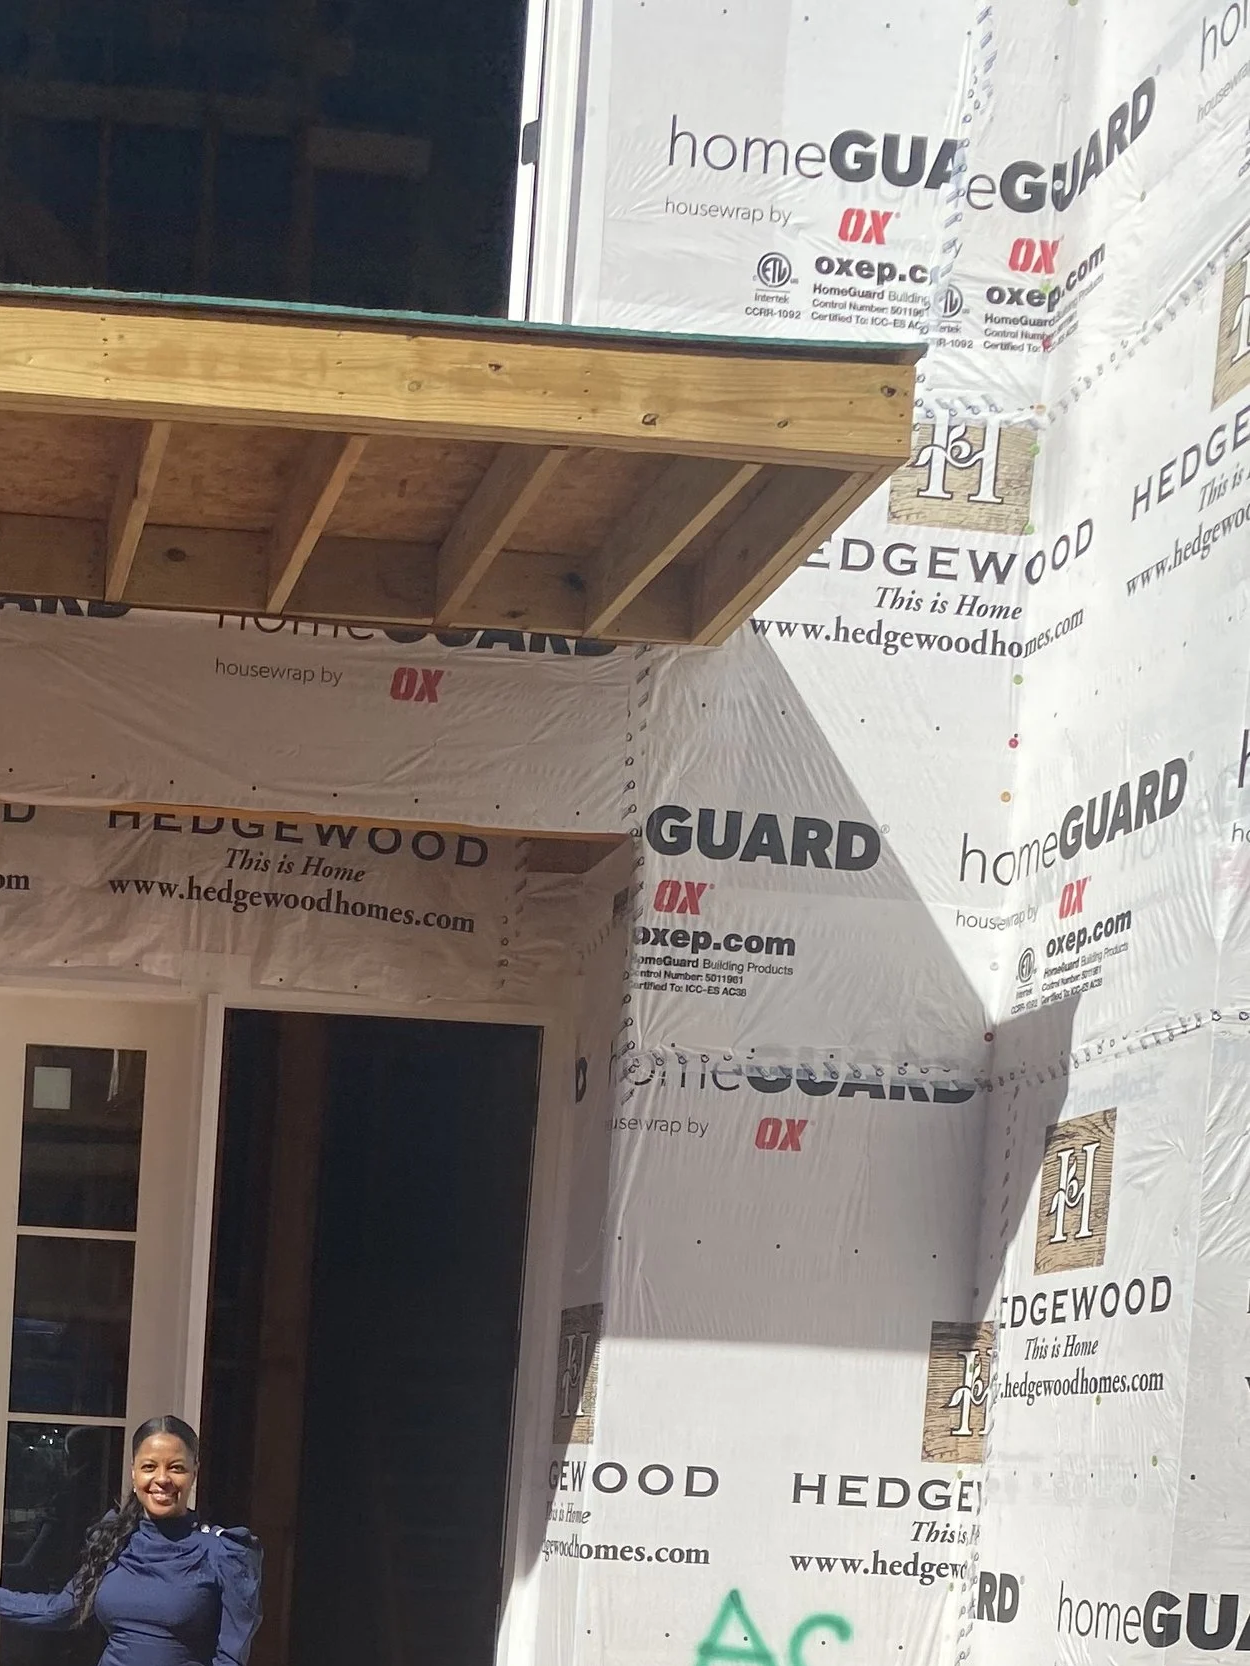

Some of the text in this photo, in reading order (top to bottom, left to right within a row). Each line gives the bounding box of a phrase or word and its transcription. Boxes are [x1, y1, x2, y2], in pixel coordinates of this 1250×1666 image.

[665, 196, 792, 227] housewrap by
[838, 207, 892, 245] OX
[1008, 237, 1060, 275] OX
[813, 284, 884, 300] HomeGuard
[986, 243, 1106, 312] oxep.com
[754, 293, 790, 304] Intertek
[812, 299, 847, 311] Control
[811, 312, 853, 324] Certified
[1198, 473, 1229, 513] This
[1231, 462, 1245, 491] is
[875, 585, 1023, 620] This is Home
[749, 607, 1084, 660] www.hedgewoodhomes.com
[215, 658, 343, 688] housewrap by
[390, 666, 445, 704] OX
[646, 805, 881, 872] GUARD
[960, 757, 1187, 886] homeGUARD
[225, 848, 366, 882] This is Home
[108, 876, 475, 933] www.hedgewoodhomes.com
[653, 880, 707, 915] OX
[1059, 876, 1088, 919] OX
[1046, 910, 1131, 958] oxep.com
[664, 971, 702, 982] Number:
[703, 960, 794, 976] Building Products
[685, 984, 720, 996] ICC-ES
[688, 1117, 708, 1138] by
[755, 1117, 809, 1151] OX
[1024, 1334, 1098, 1361] This is Home
[566, 1502, 591, 1524] Home
[910, 1520, 955, 1544] This
